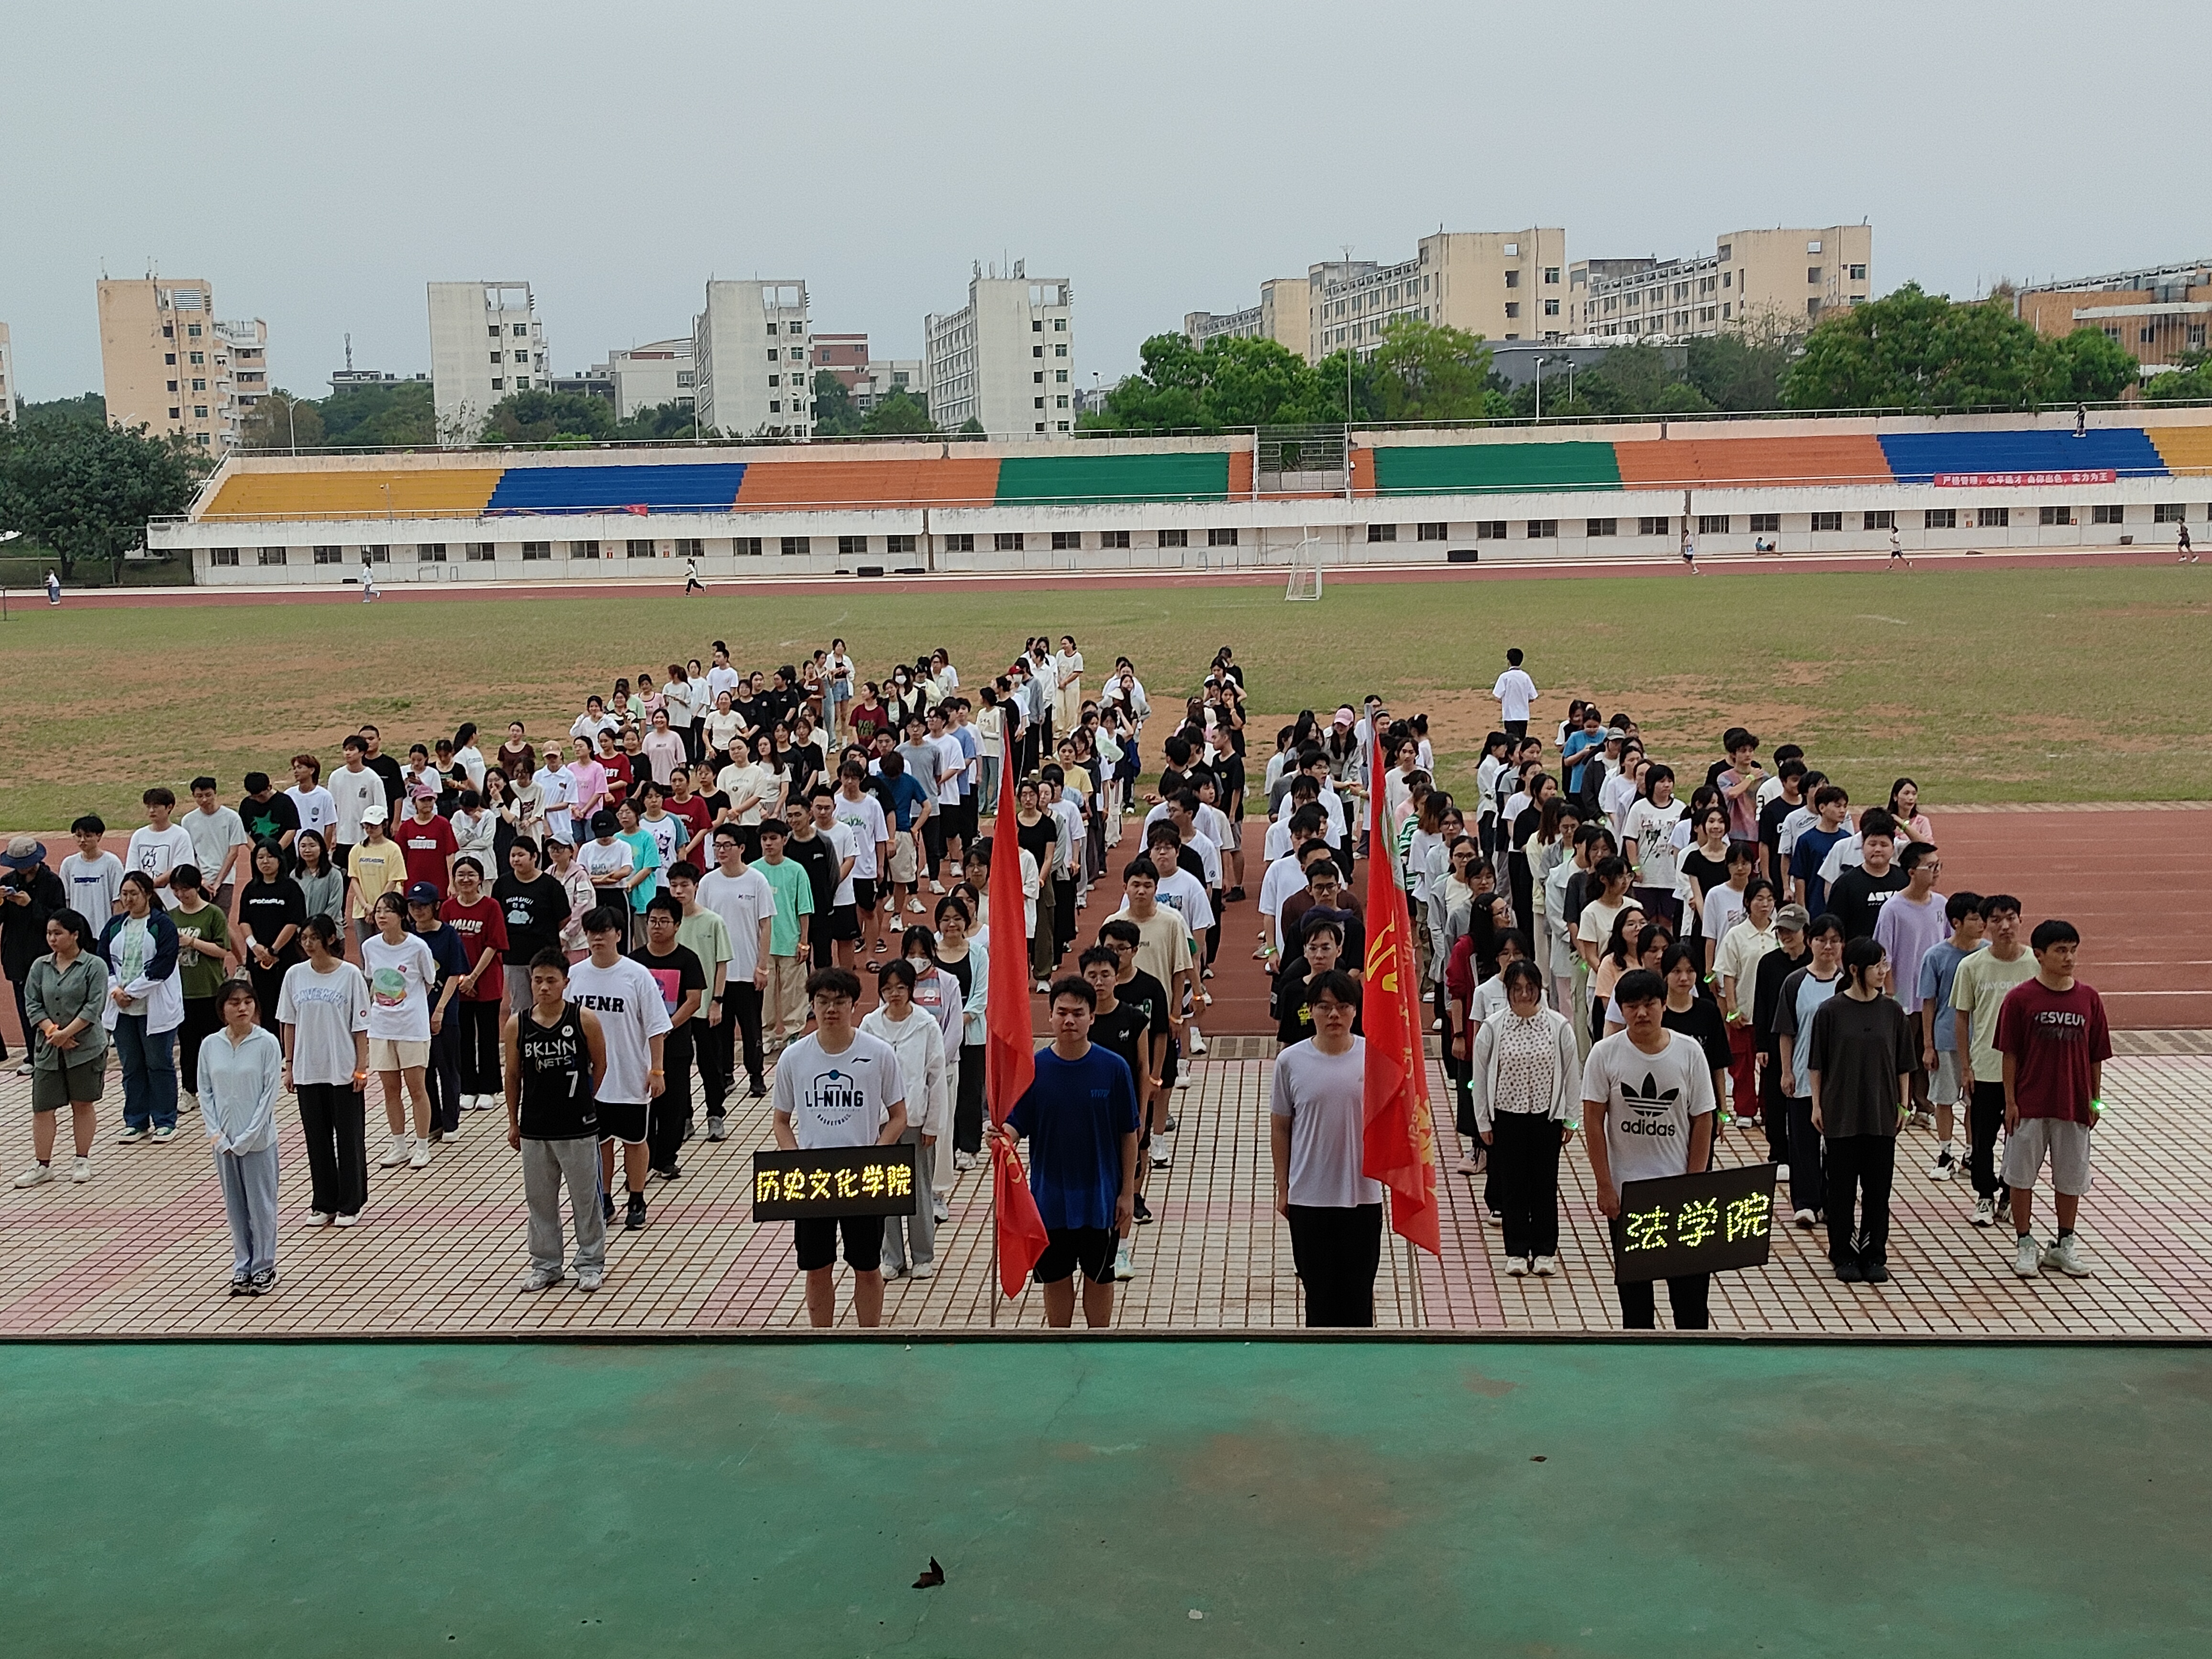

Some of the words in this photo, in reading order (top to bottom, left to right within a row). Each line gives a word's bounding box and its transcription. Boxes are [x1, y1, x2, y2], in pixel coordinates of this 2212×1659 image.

[525, 1039, 577, 1058] BKLYN
[566, 1071, 578, 1098] 7
[805, 1090, 863, 1107] LI-NING
[817, 1113, 852, 1126] BASKETBALL
[1620, 1119, 1676, 1137] adidas
[756, 1163, 912, 1203] 历史文化学院
[1625, 1191, 1770, 1252] 法学院
